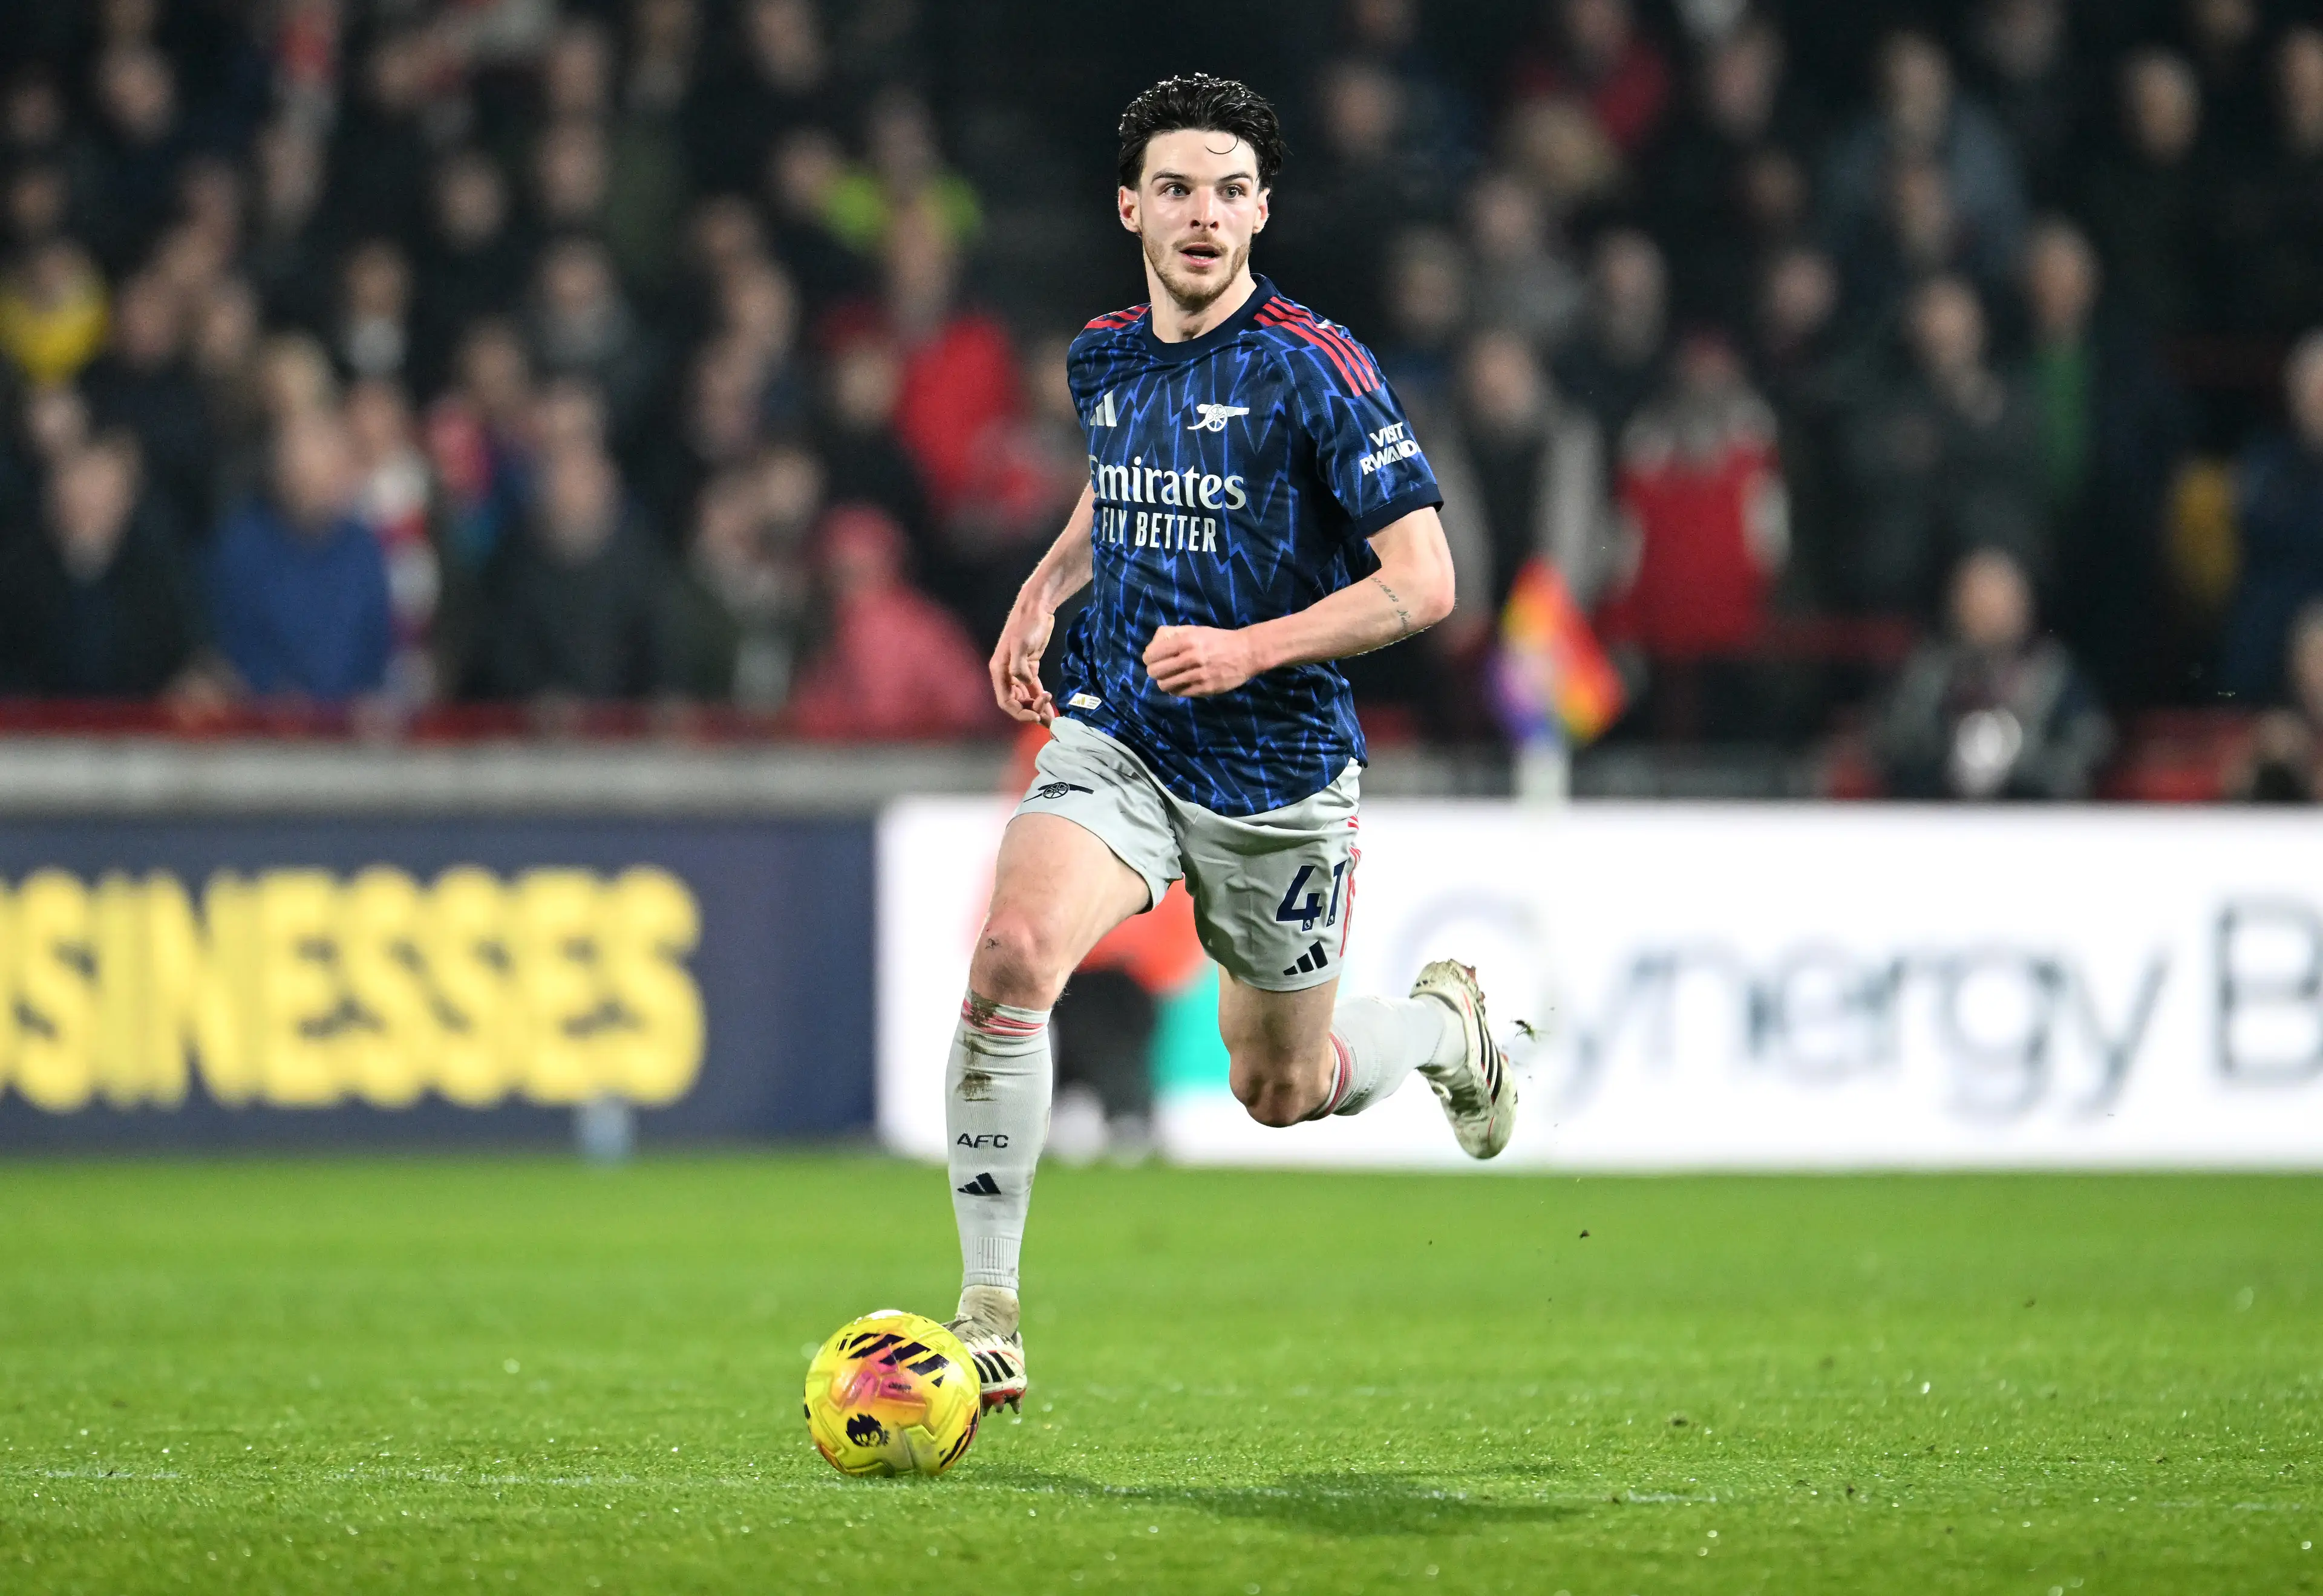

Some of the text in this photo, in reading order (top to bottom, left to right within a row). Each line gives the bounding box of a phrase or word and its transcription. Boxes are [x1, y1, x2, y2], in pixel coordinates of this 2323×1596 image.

[1360, 440, 1422, 475] RWAND
[1102, 507, 1217, 552] FLY BETTER
[1276, 859, 1348, 932] 41
[0, 866, 707, 1112] SINESSES
[957, 1133, 1009, 1148] AFC
